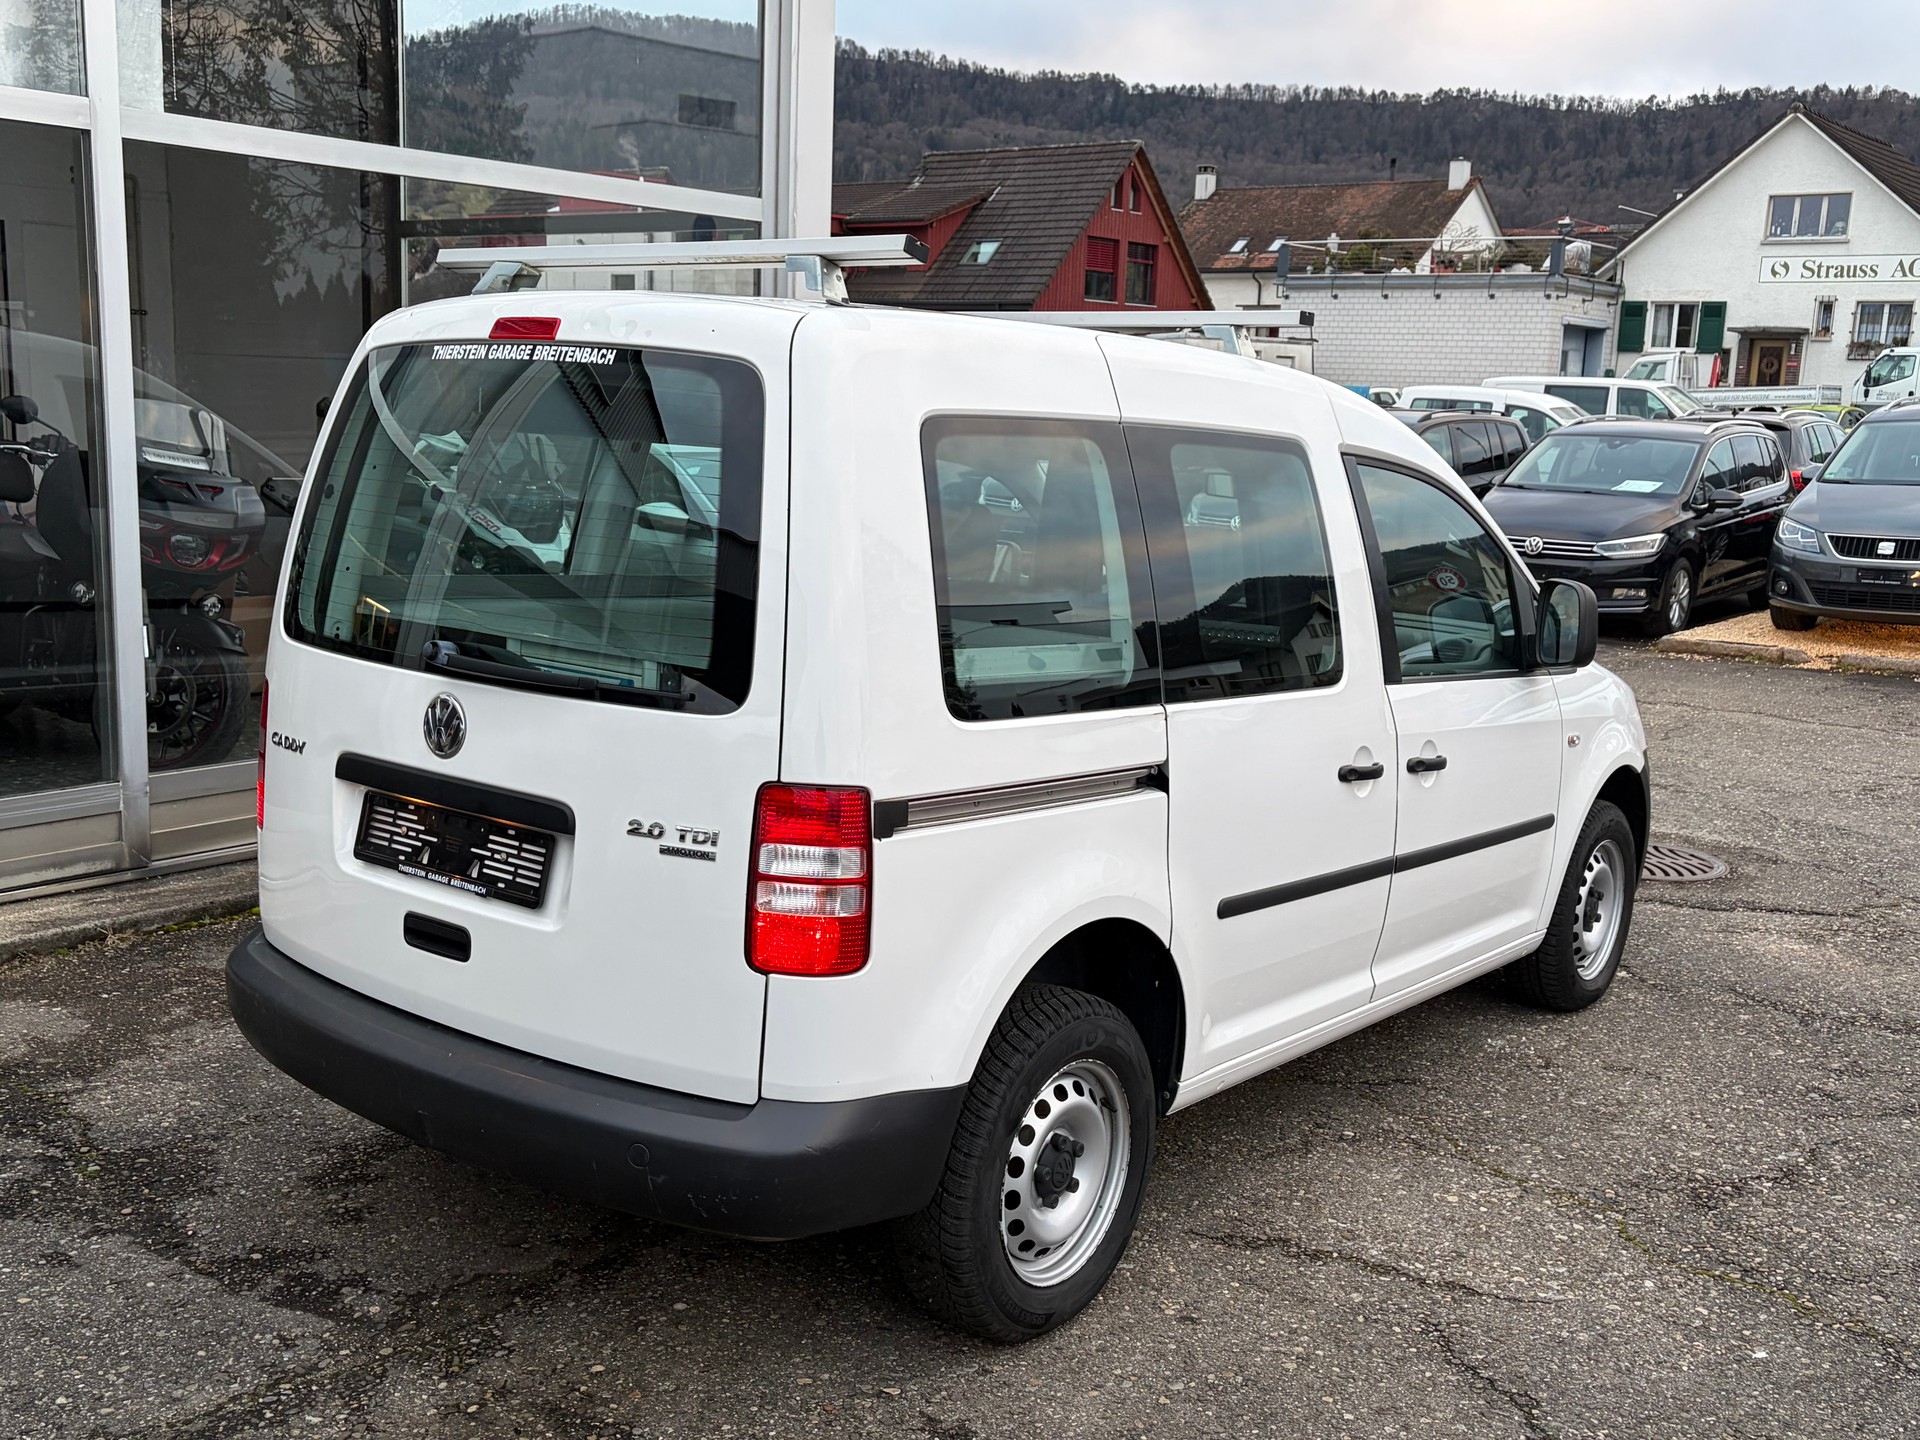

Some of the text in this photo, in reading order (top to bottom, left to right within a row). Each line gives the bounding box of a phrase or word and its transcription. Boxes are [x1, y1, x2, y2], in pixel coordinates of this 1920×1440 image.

[1800, 257, 1920, 279] Strauss AG
[431, 344, 617, 365] THIERSTEIN GARAGE BREITENBACH
[271, 731, 307, 755] CADDY
[398, 863, 487, 895] THIERSTEIN GARAGE BREITENBACH
